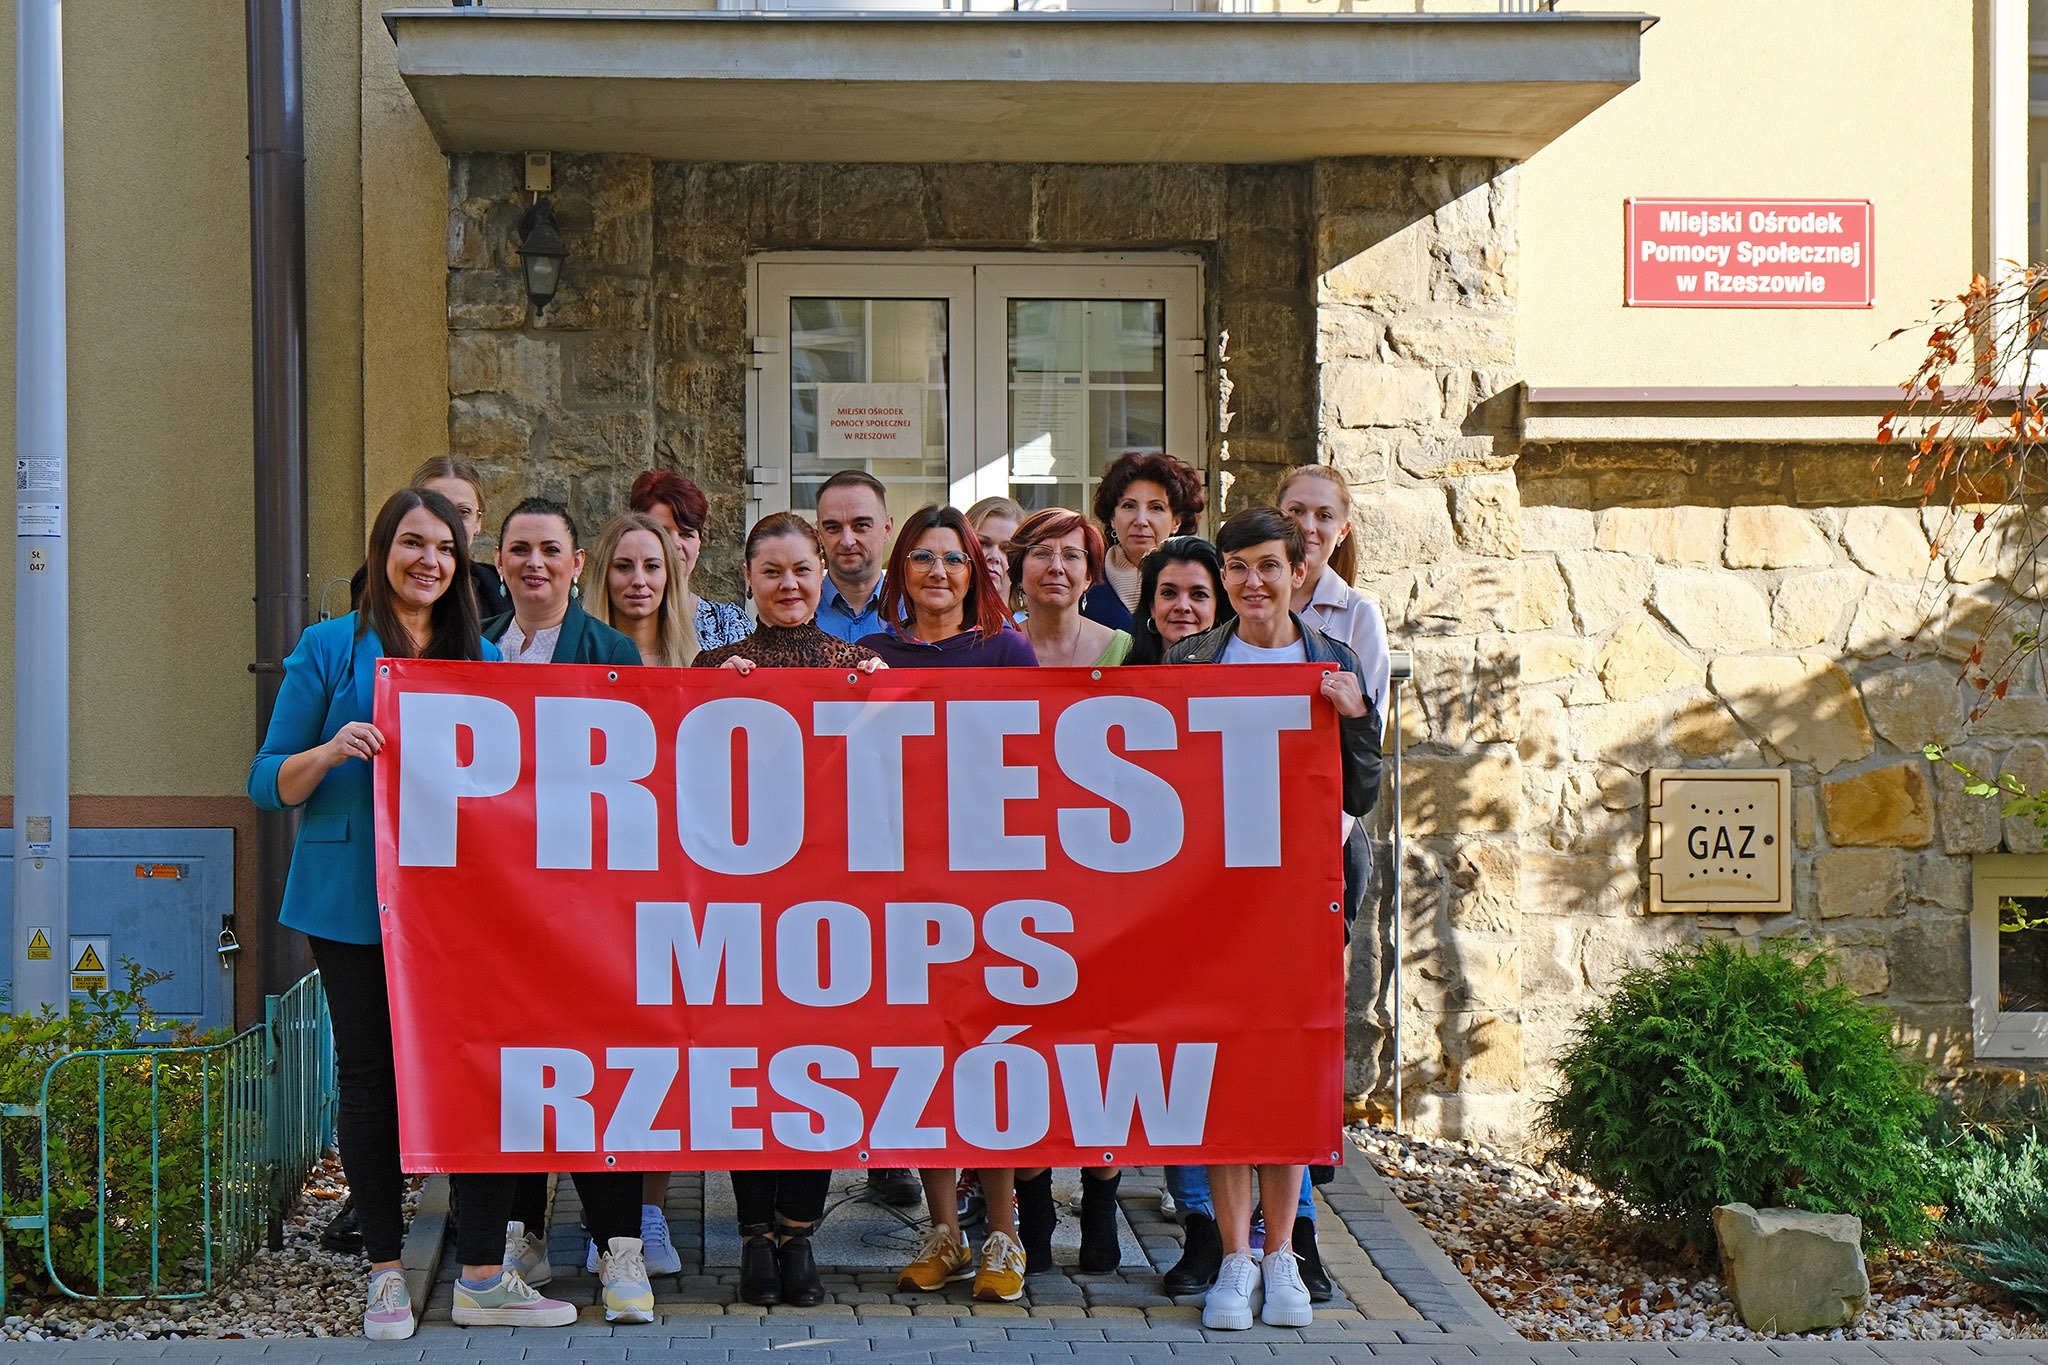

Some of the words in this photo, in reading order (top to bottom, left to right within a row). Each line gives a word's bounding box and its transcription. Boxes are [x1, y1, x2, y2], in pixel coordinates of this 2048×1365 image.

[1659, 210, 1743, 237] Miejski
[1748, 210, 1844, 234] Ośrodek
[1641, 240, 1732, 267] Pomocy
[1736, 240, 1861, 267] Społecznej
[1675, 274, 1698, 293] w
[1703, 270, 1826, 294] Rzeszowie
[830, 419, 864, 427] POMOCY
[866, 419, 911, 427] SPOŁECZNEJ
[837, 407, 866, 415] MIEJSKI
[867, 406, 904, 415] OŚRODEK
[844, 432, 852, 440] W
[854, 432, 897, 440] RZESZOWIE
[29, 562, 45, 572] 047
[397, 692, 1312, 875] PROTEST
[1687, 825, 1756, 860] GAZ
[635, 898, 1079, 1008] MOPS
[500, 1024, 1218, 1155] RZESZÓW
